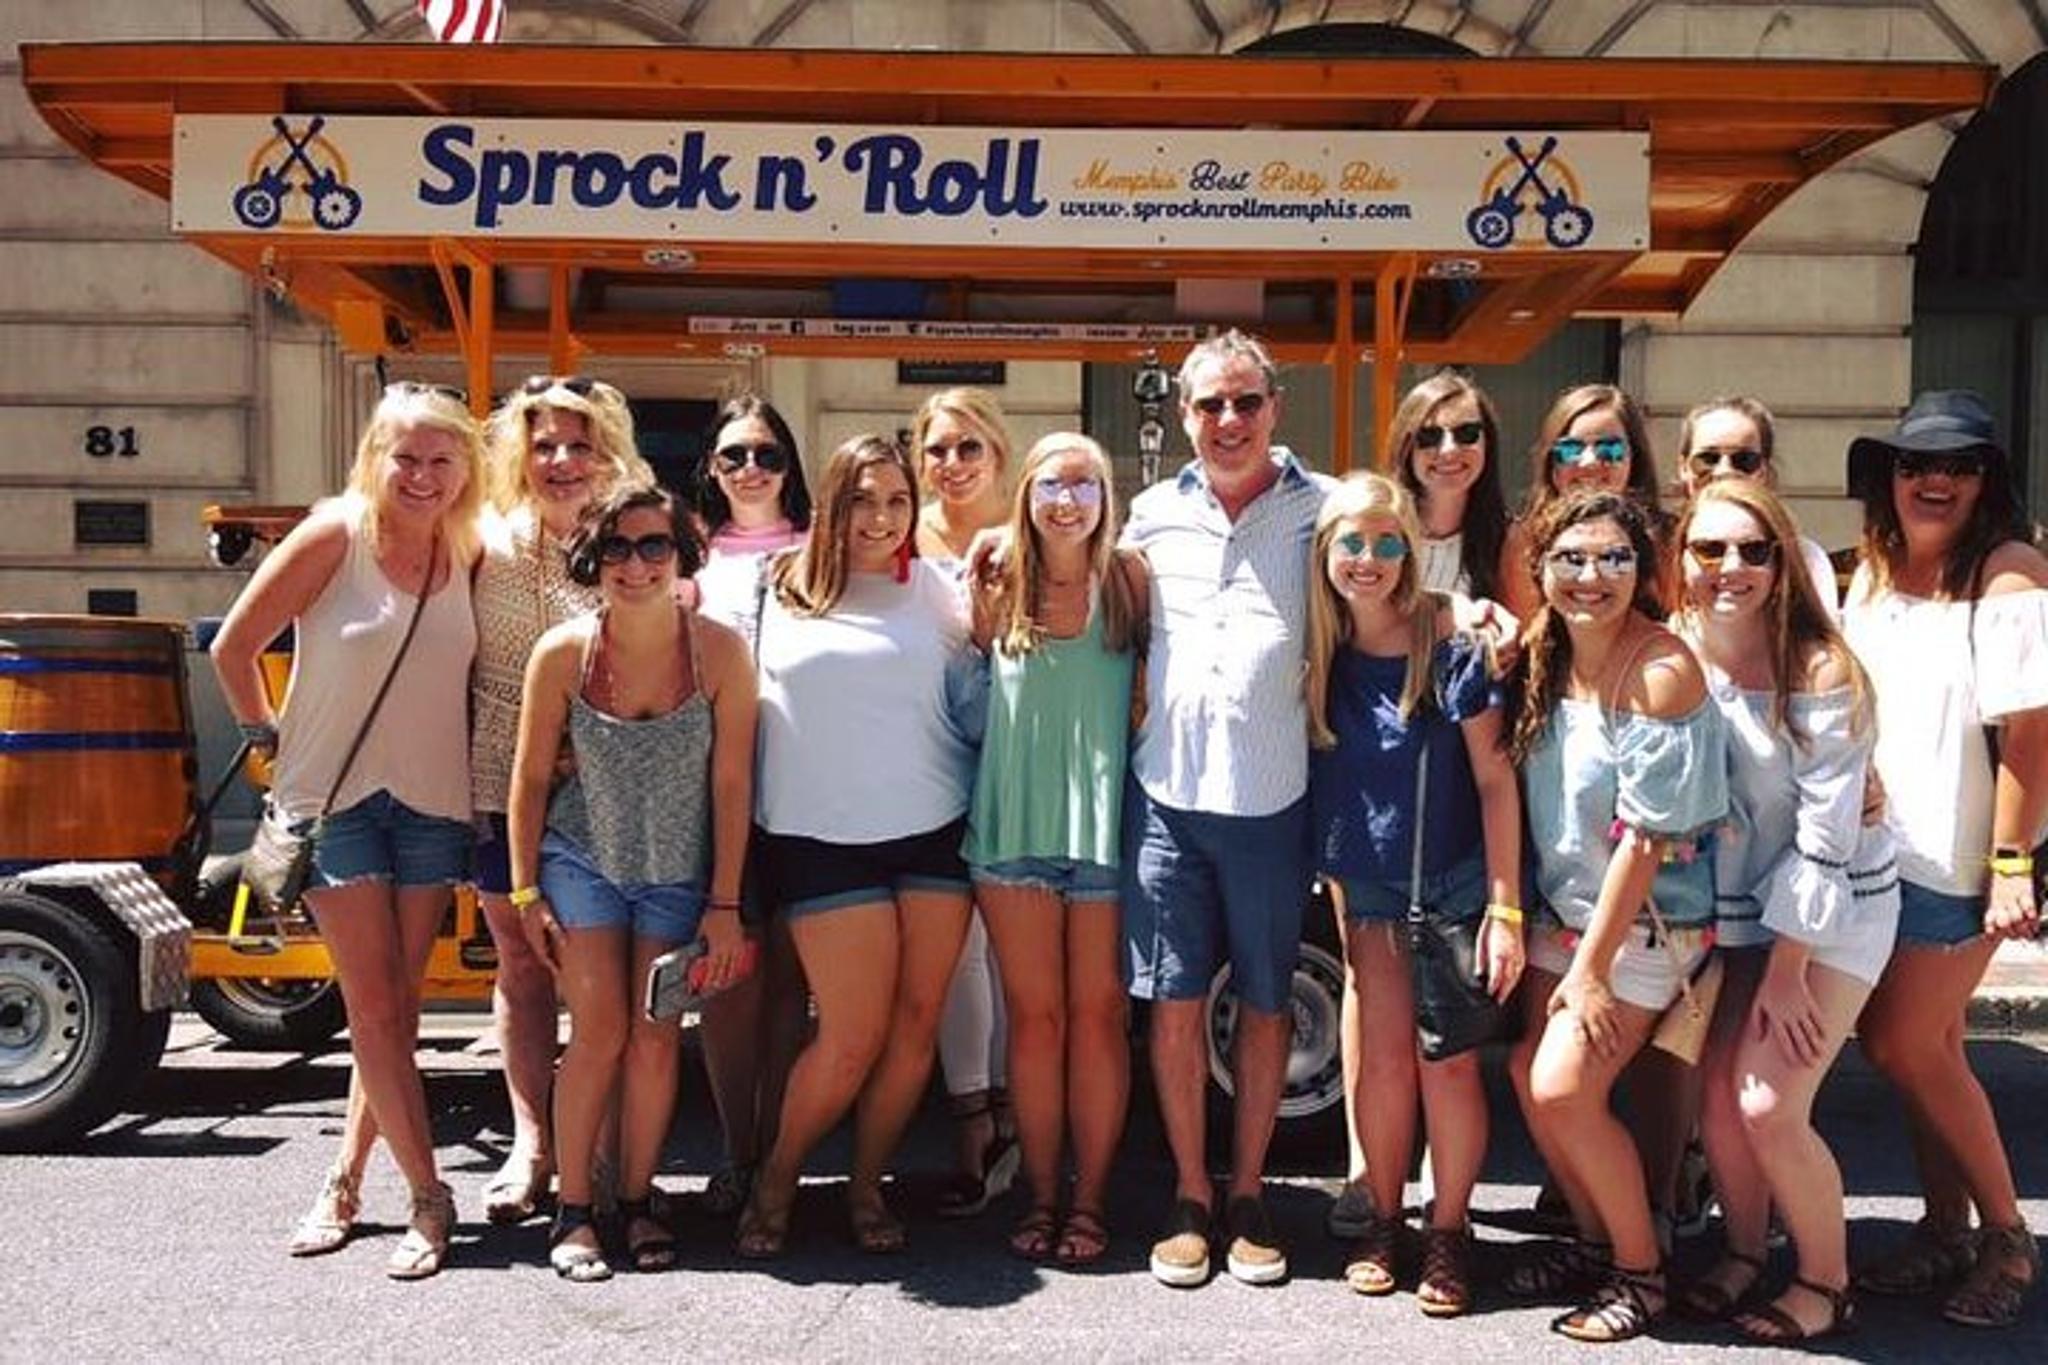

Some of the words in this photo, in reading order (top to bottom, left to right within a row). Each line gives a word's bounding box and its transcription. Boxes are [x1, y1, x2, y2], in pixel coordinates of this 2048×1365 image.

[419, 125, 741, 228] Sprock
[1189, 160, 1250, 191] Best
[1259, 161, 1326, 197] Party
[1339, 161, 1400, 192] Bike
[1060, 198, 1412, 223] www.sprocknrollmemphis.com
[85, 425, 140, 457] 81
